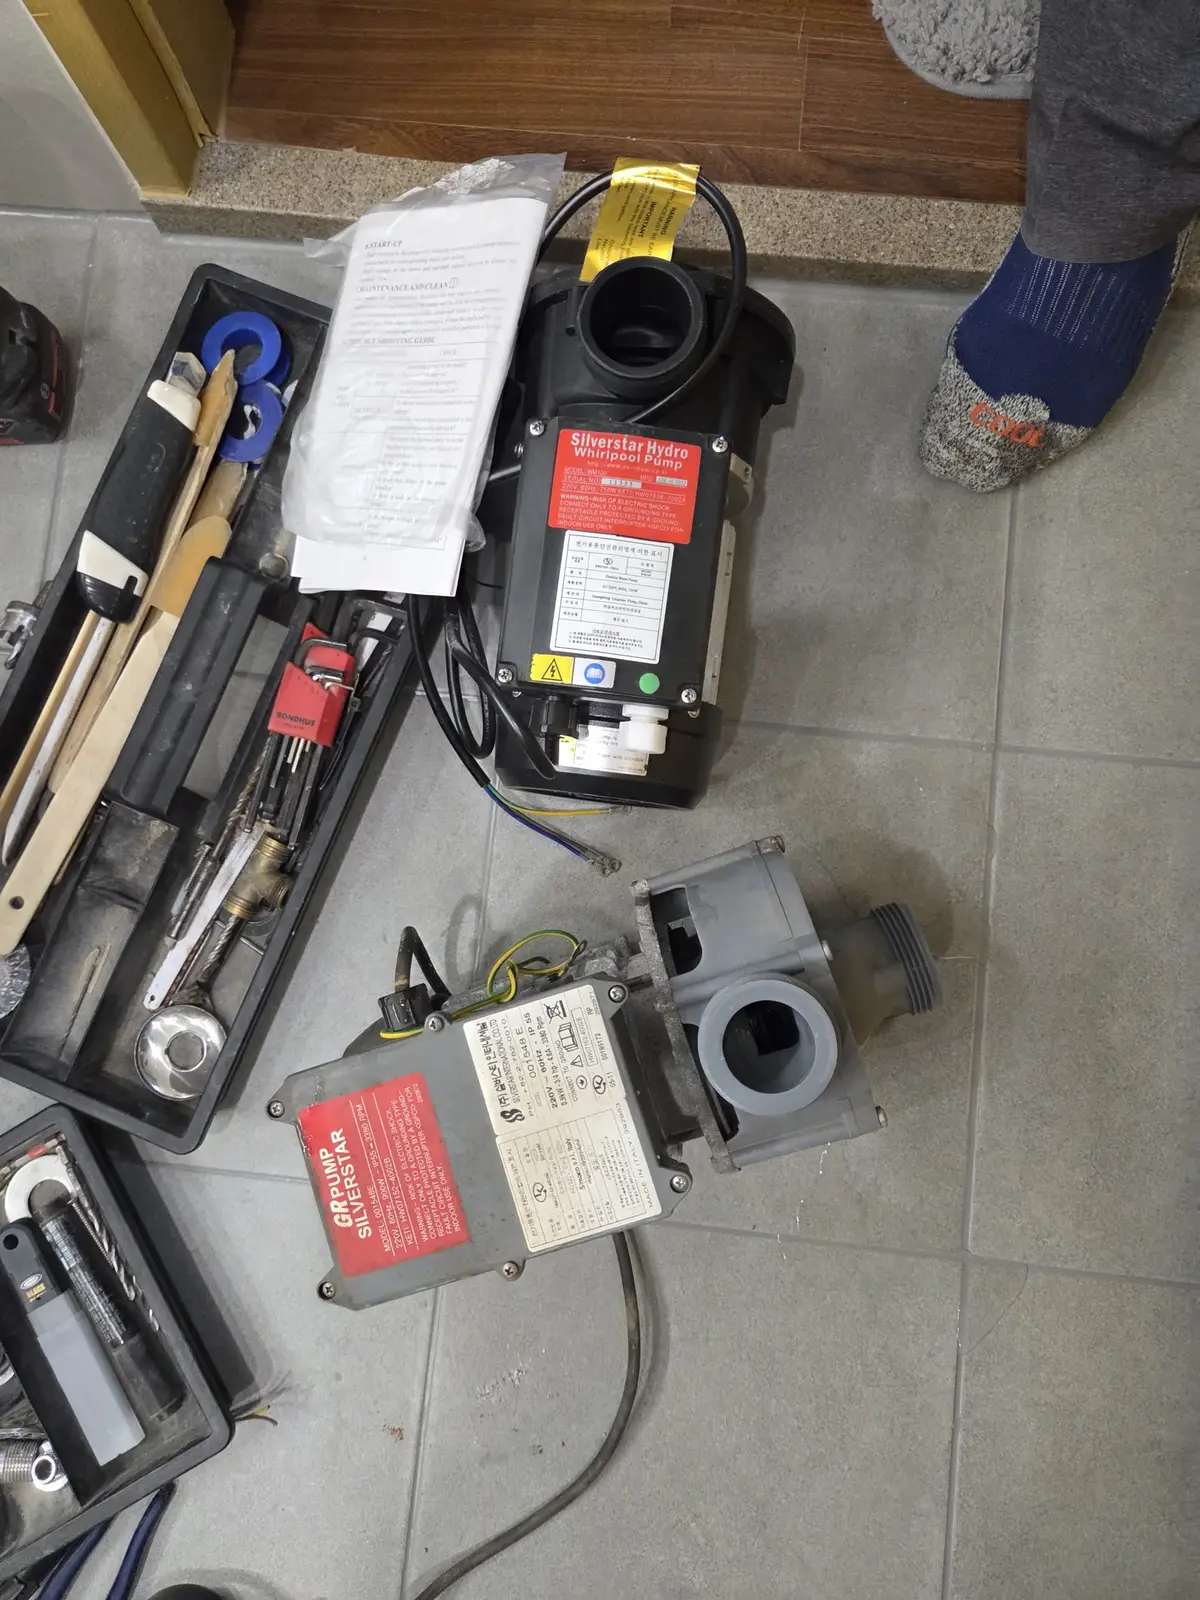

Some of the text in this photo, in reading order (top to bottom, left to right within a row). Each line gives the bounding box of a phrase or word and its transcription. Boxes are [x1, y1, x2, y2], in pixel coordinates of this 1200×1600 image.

[637, 200, 656, 238] IMPORTANT
[654, 216, 663, 231] MUST
[660, 206, 676, 236] WARNING
[413, 336, 436, 344] GUIDE
[570, 432, 688, 460] Silverstar Hydro
[573, 446, 640, 465] Whirlpool
[644, 454, 683, 470] Pump
[559, 499, 589, 508] CONNECT
[617, 499, 647, 508] ELECTRIC
[276, 711, 315, 726] BONDHUS
[515, 1026, 523, 1035] E
[535, 1015, 544, 1029] Rpm
[494, 1036, 512, 1076] INTERNATIONAL
[523, 1012, 557, 1108] 220V 60Hz IP 55
[554, 1039, 578, 1101] CONNECT TO GROUND
[404, 1086, 414, 1101] FOR
[506, 1075, 520, 1103] SILVERSTAR
[355, 1103, 366, 1121] RPM
[390, 1099, 401, 1116] TYPE
[360, 1122, 372, 1142] 3380
[396, 1118, 414, 1162] GROUNDING
[410, 1134, 418, 1143] BY
[392, 1135, 408, 1169] ELECTRIC
[417, 1130, 437, 1179] INTERRUPTER
[403, 1170, 412, 1181] OF
[411, 1170, 420, 1180] TO
[413, 1145, 431, 1188] PROTECTED
[627, 1139, 653, 1207] MADE IN ITALY
[318, 1146, 353, 1229] GR PUMP
[329, 1127, 373, 1238] SILVERSTAR
[376, 1177, 389, 1199] 900W
[406, 1182, 417, 1199] RISK
[415, 1182, 426, 1201] ONLY
[431, 1180, 446, 1209] CIRCUIT
[442, 1185, 452, 1200] USE
[413, 1206, 429, 1241] WARNING
[421, 1203, 437, 1238] CONNECT
[425, 1189, 445, 1236] RECEPTACLE
[440, 1211, 453, 1234] FAULT
[446, 1202, 461, 1231] INDOOR
